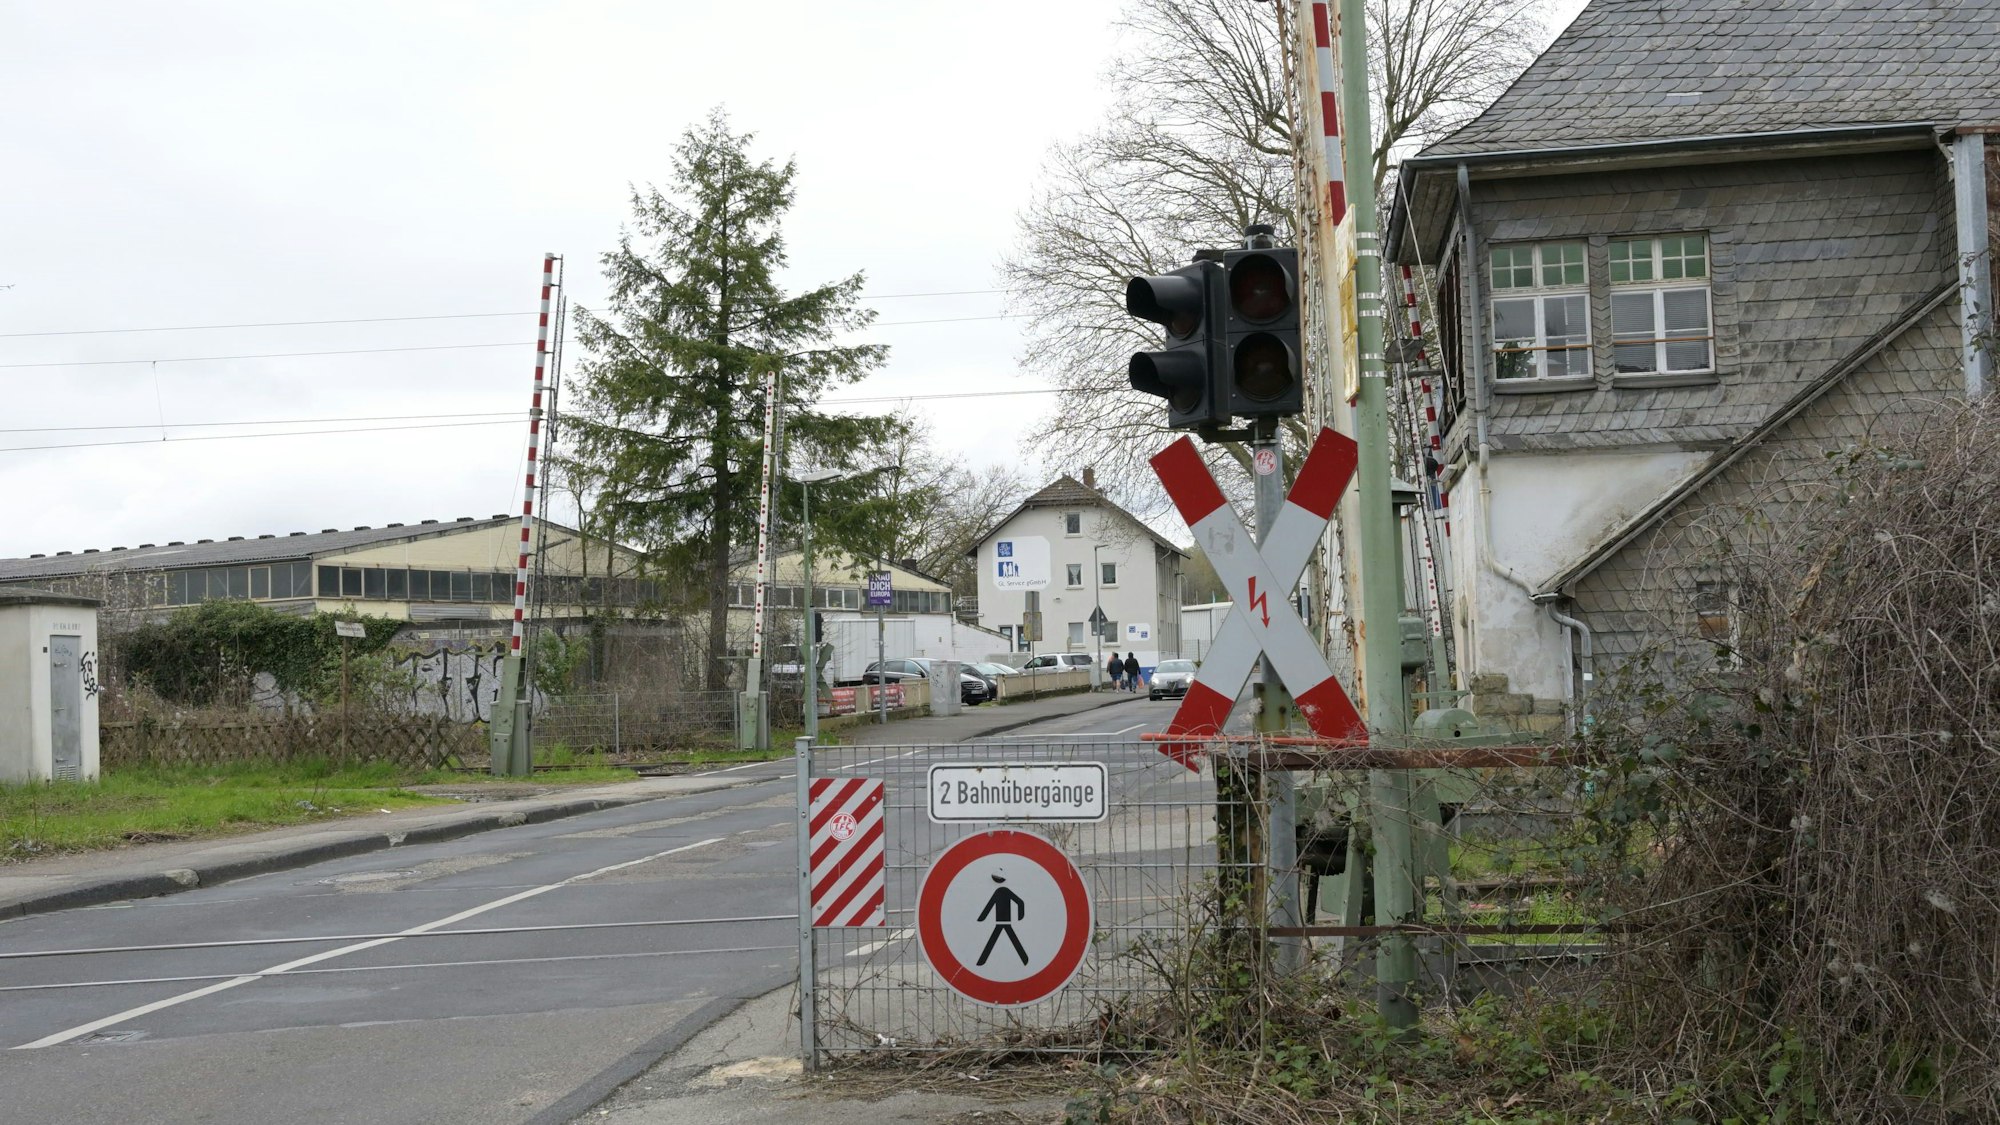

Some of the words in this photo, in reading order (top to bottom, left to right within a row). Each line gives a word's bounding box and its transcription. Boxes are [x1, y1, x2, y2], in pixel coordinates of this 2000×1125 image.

[870, 581, 891, 591] DICH
[940, 781, 951, 804] 2
[957, 779, 1094, 807] Bahnübergänge
